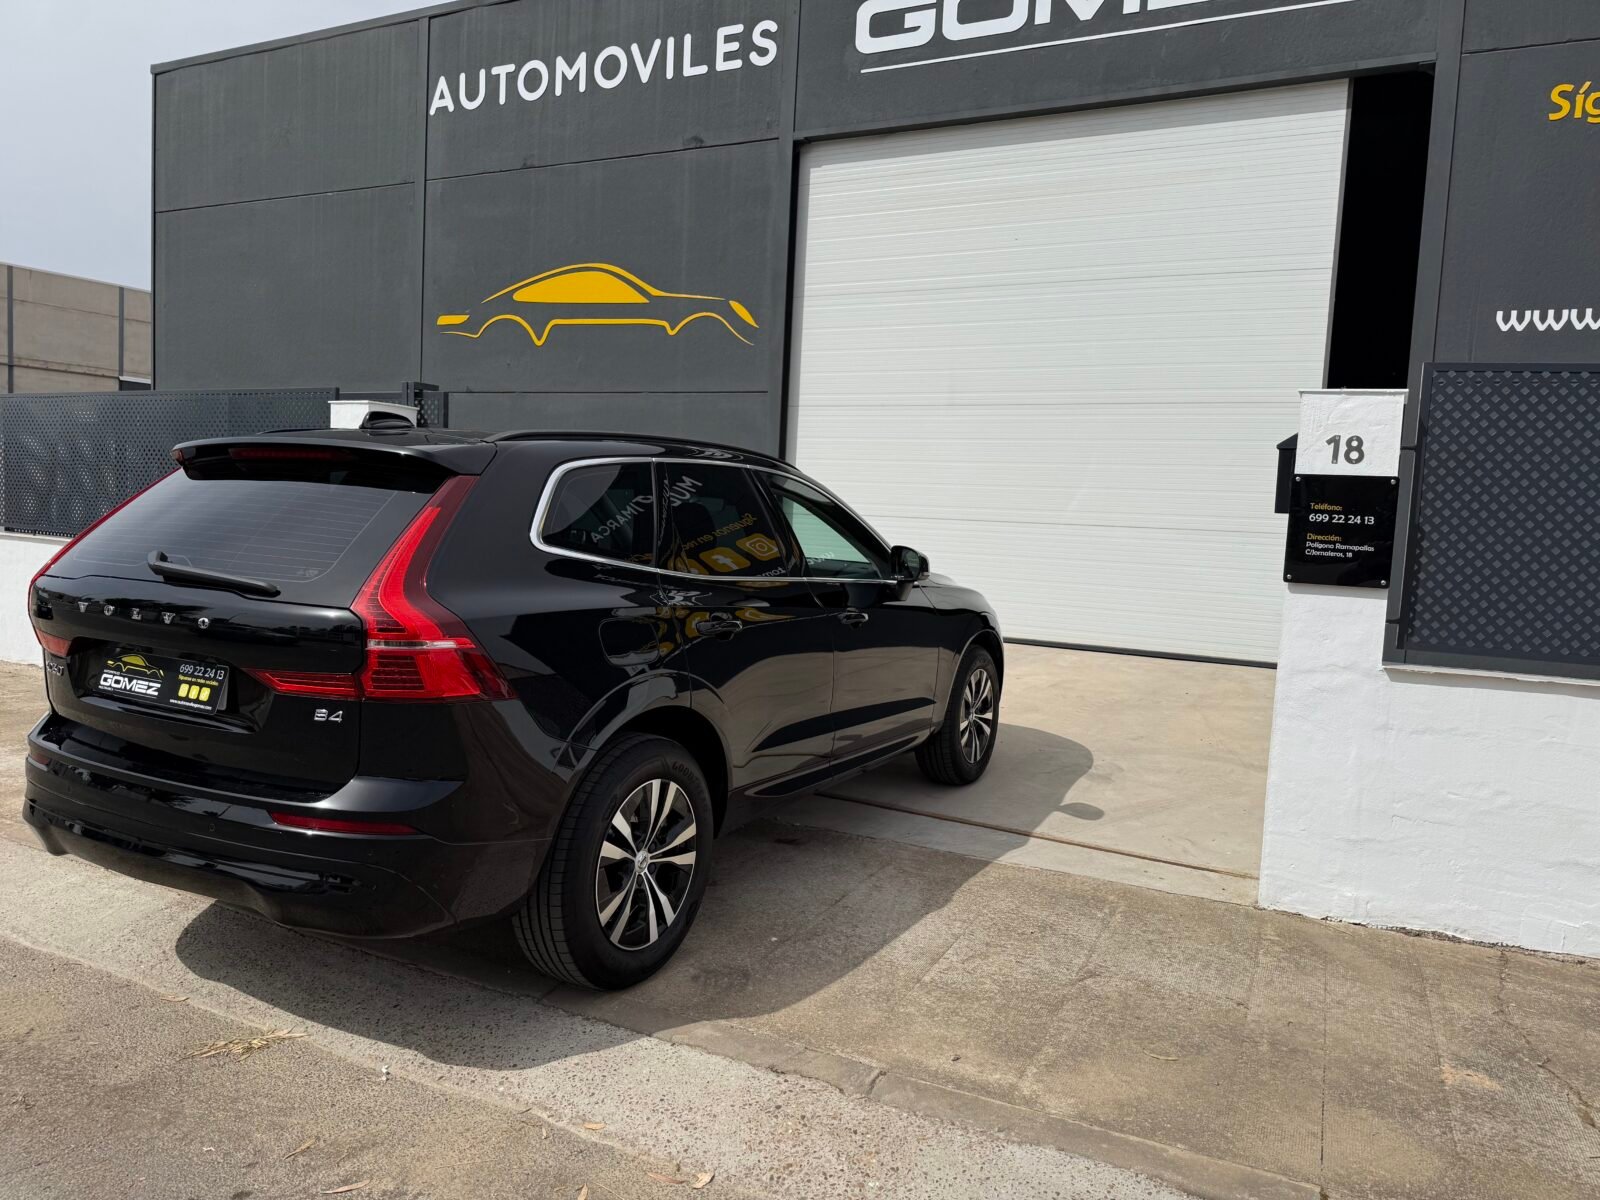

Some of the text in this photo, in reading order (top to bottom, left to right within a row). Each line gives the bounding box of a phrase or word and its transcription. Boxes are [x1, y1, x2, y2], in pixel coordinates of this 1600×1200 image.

[855, 0, 1204, 54] GO
[429, 19, 779, 116] AUTOMOVILES
[1325, 434, 1365, 465] 18
[1308, 513, 1375, 525] 699 22 24 13
[1306, 533, 1342, 542] Dirección:
[77, 601, 210, 629] VOLVO
[179, 663, 225, 680] 699 22 24 13
[99, 673, 162, 696] GOMEZ
[313, 708, 343, 723] B4
